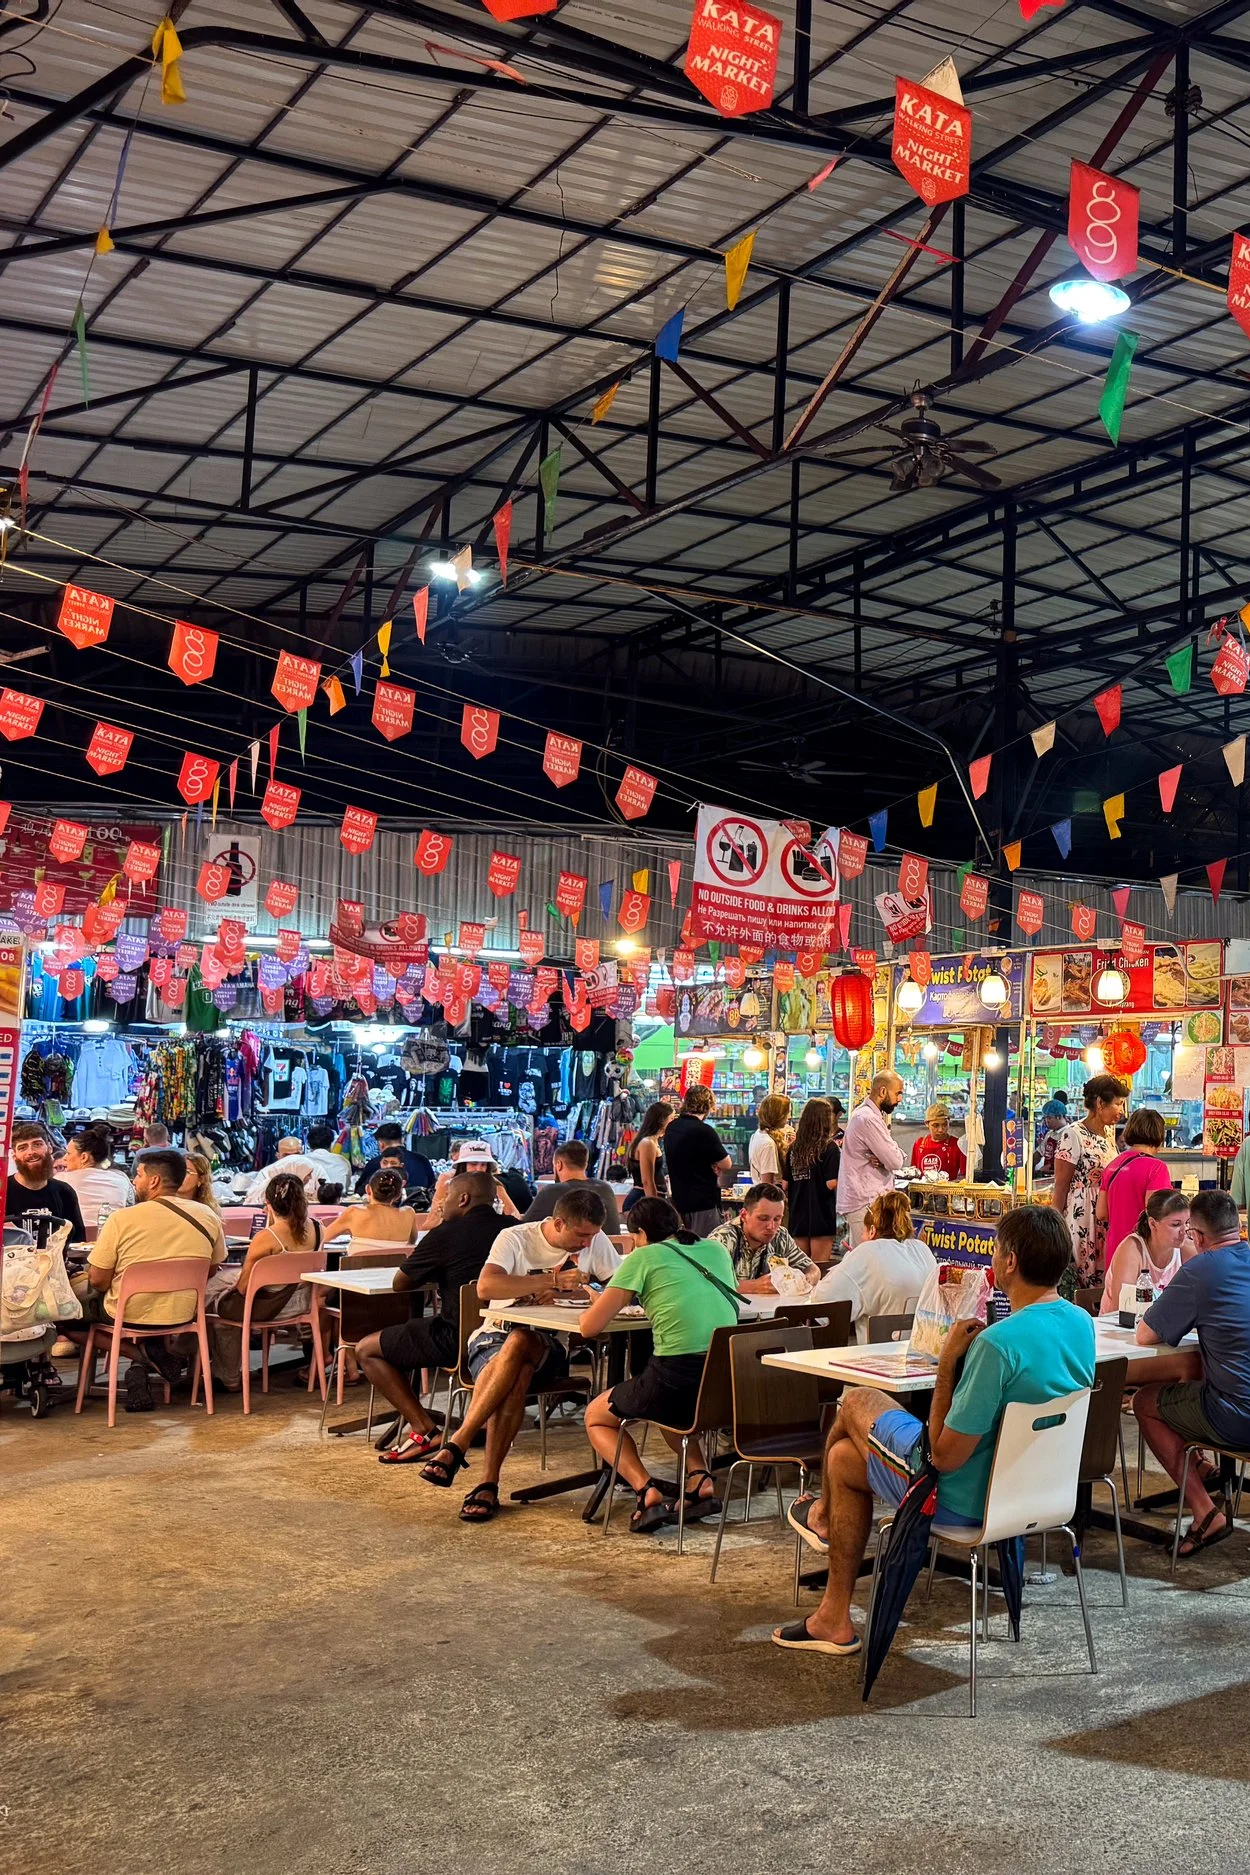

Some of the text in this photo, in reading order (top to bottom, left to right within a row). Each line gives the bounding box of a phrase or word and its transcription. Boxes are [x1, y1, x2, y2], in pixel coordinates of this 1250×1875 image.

[701, 0, 774, 43] KATA
[698, 17, 774, 54] WALKING STREET
[707, 45, 764, 74] NIGHT
[690, 56, 771, 96] MARKET
[900, 93, 964, 137] KATA
[899, 112, 966, 147] WALKING STREET
[907, 139, 953, 165] NIGHT
[895, 146, 965, 184] MARKET
[1225, 639, 1250, 665] KATA
[1214, 664, 1244, 687] MARKET
[1221, 660, 1241, 677] NIGHT
[6, 692, 41, 710] KATA
[6, 710, 31, 723] NIGHT
[97, 728, 129, 745] KATA
[88, 751, 123, 766] MARKET
[96, 746, 119, 759] NIGHT
[268, 785, 297, 800] KATA
[263, 806, 294, 821] MARKET
[269, 802, 290, 814] NIGHT
[347, 810, 374, 826] KATA
[341, 831, 370, 846] MARKET
[347, 827, 367, 839] NIGHT
[492, 856, 518, 870] KATA
[489, 876, 515, 888] MARKET
[493, 872, 512, 882] NIGHT
[560, 876, 584, 889] KATA
[556, 897, 581, 908] MARKET
[560, 892, 579, 902] NIGHT
[698, 889, 710, 902] NO
[711, 891, 743, 909] OUTSIDE
[744, 899, 766, 912] FOOD
[767, 902, 775, 914] &
[776, 903, 810, 917] DRINKS
[697, 904, 707, 915] Не
[707, 906, 747, 924] Разрешать
[768, 918, 783, 928] или
[784, 921, 817, 931] напитки
[856, 952, 874, 961] KATA
[490, 964, 508, 972] KATA
[928, 966, 955, 985] wist
[924, 1157, 939, 1165] KATA
[924, 1227, 956, 1250] Twist
